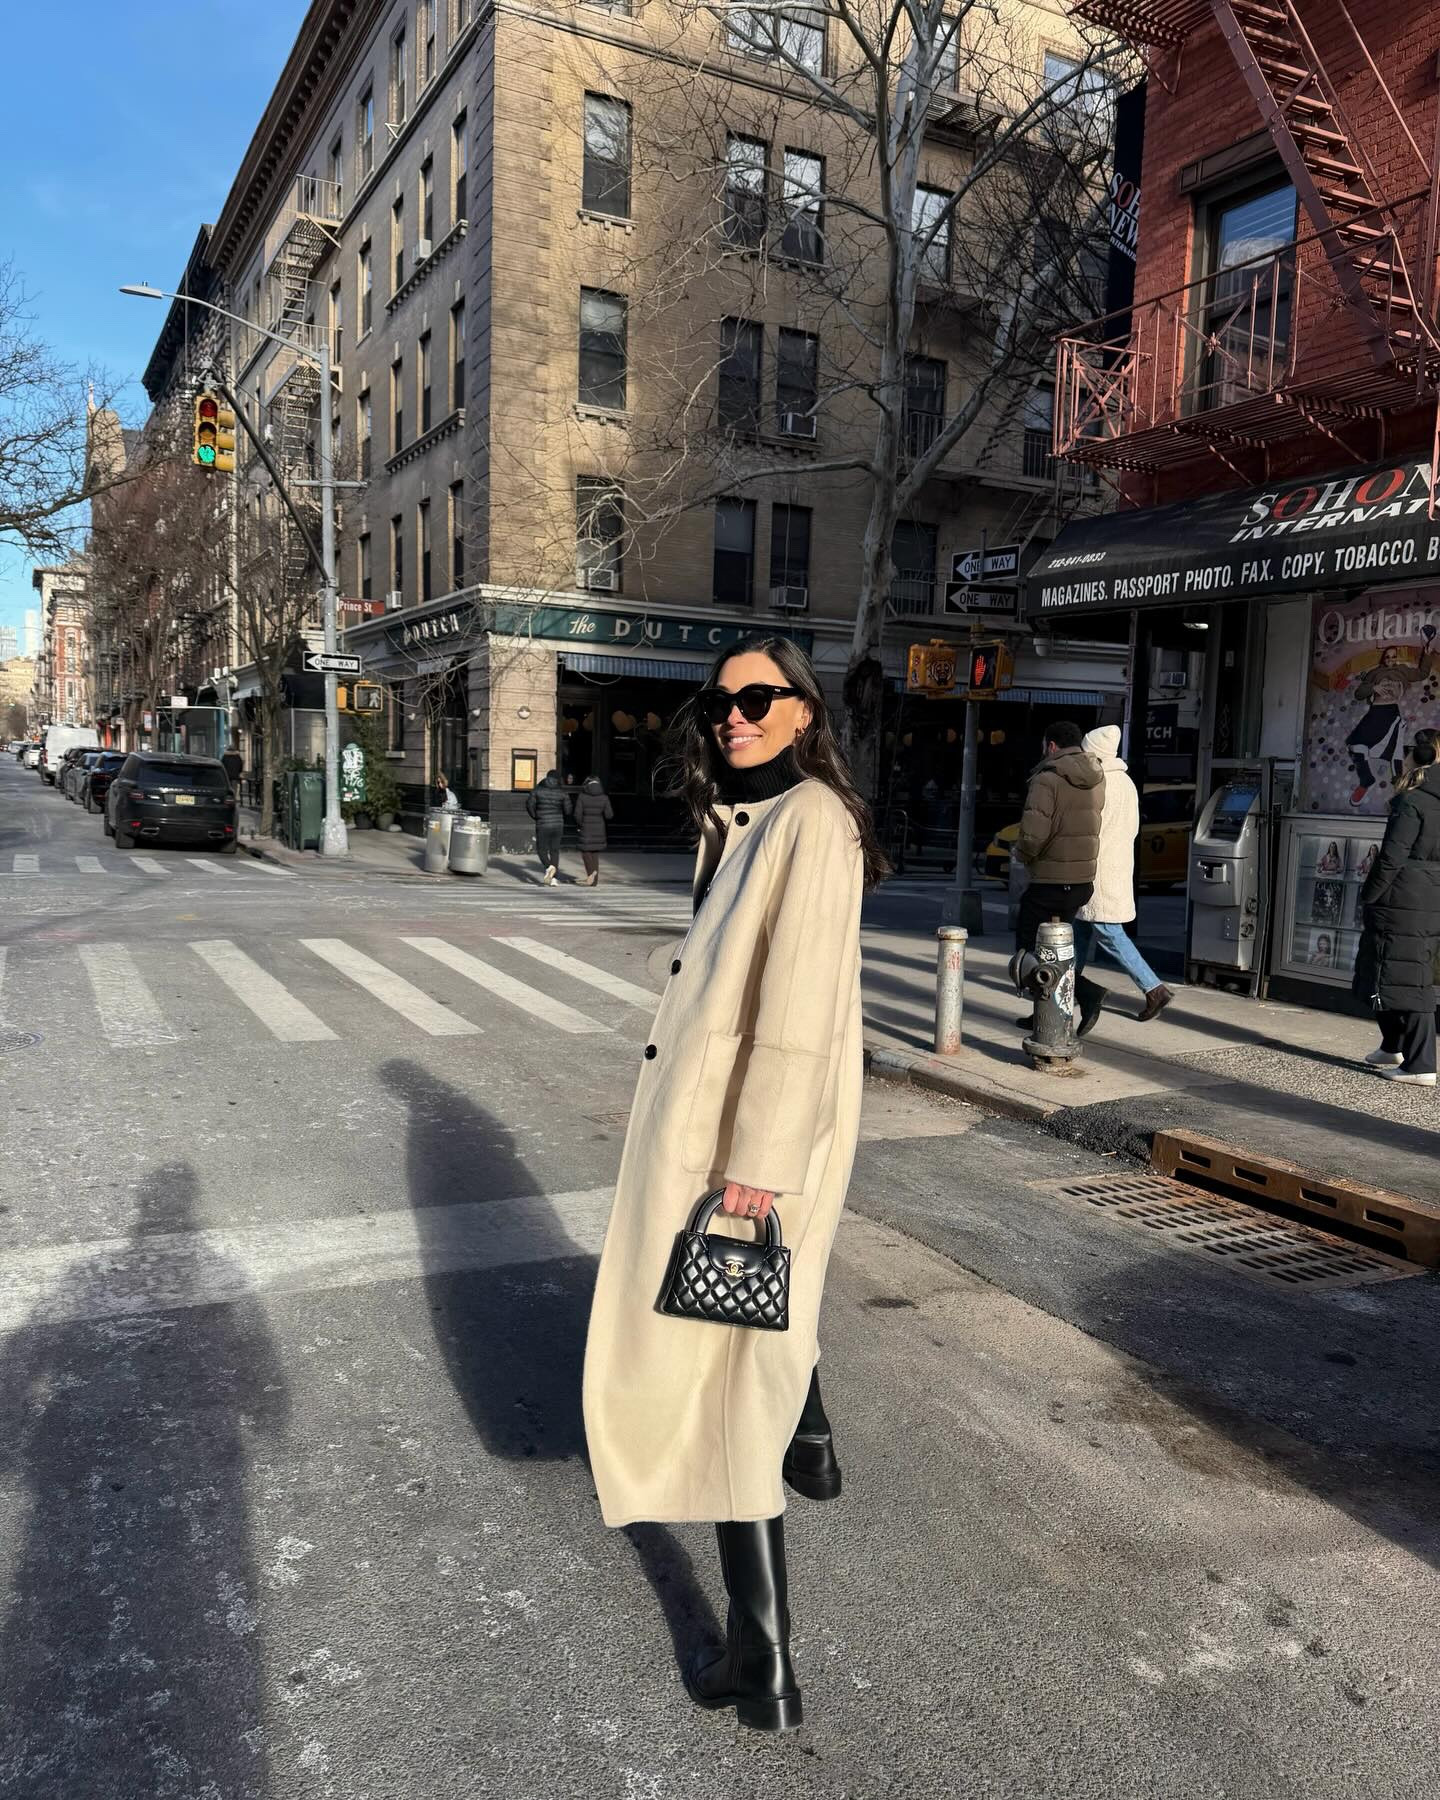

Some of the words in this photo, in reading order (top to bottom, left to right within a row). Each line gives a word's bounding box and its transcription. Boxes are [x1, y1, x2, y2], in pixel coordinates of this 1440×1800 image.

[964, 560, 981, 573] ONE
[992, 556, 1011, 570] WAY
[1041, 580, 1108, 607] MAGAZINES.
[1113, 572, 1180, 600] PASSPORT
[1184, 565, 1234, 592] PHOTO.
[1240, 559, 1274, 585] FAX.
[1281, 551, 1325, 579] COPY.
[1335, 539, 1418, 572] TOBACCO.
[1426, 536, 1440, 561] B
[340, 600, 362, 612] Prince
[364, 602, 373, 613] St
[960, 593, 979, 605] ONE
[990, 594, 1011, 608] WAY
[569, 614, 596, 634] the
[314, 658, 330, 667] ONE
[338, 660, 355, 669] WAY
